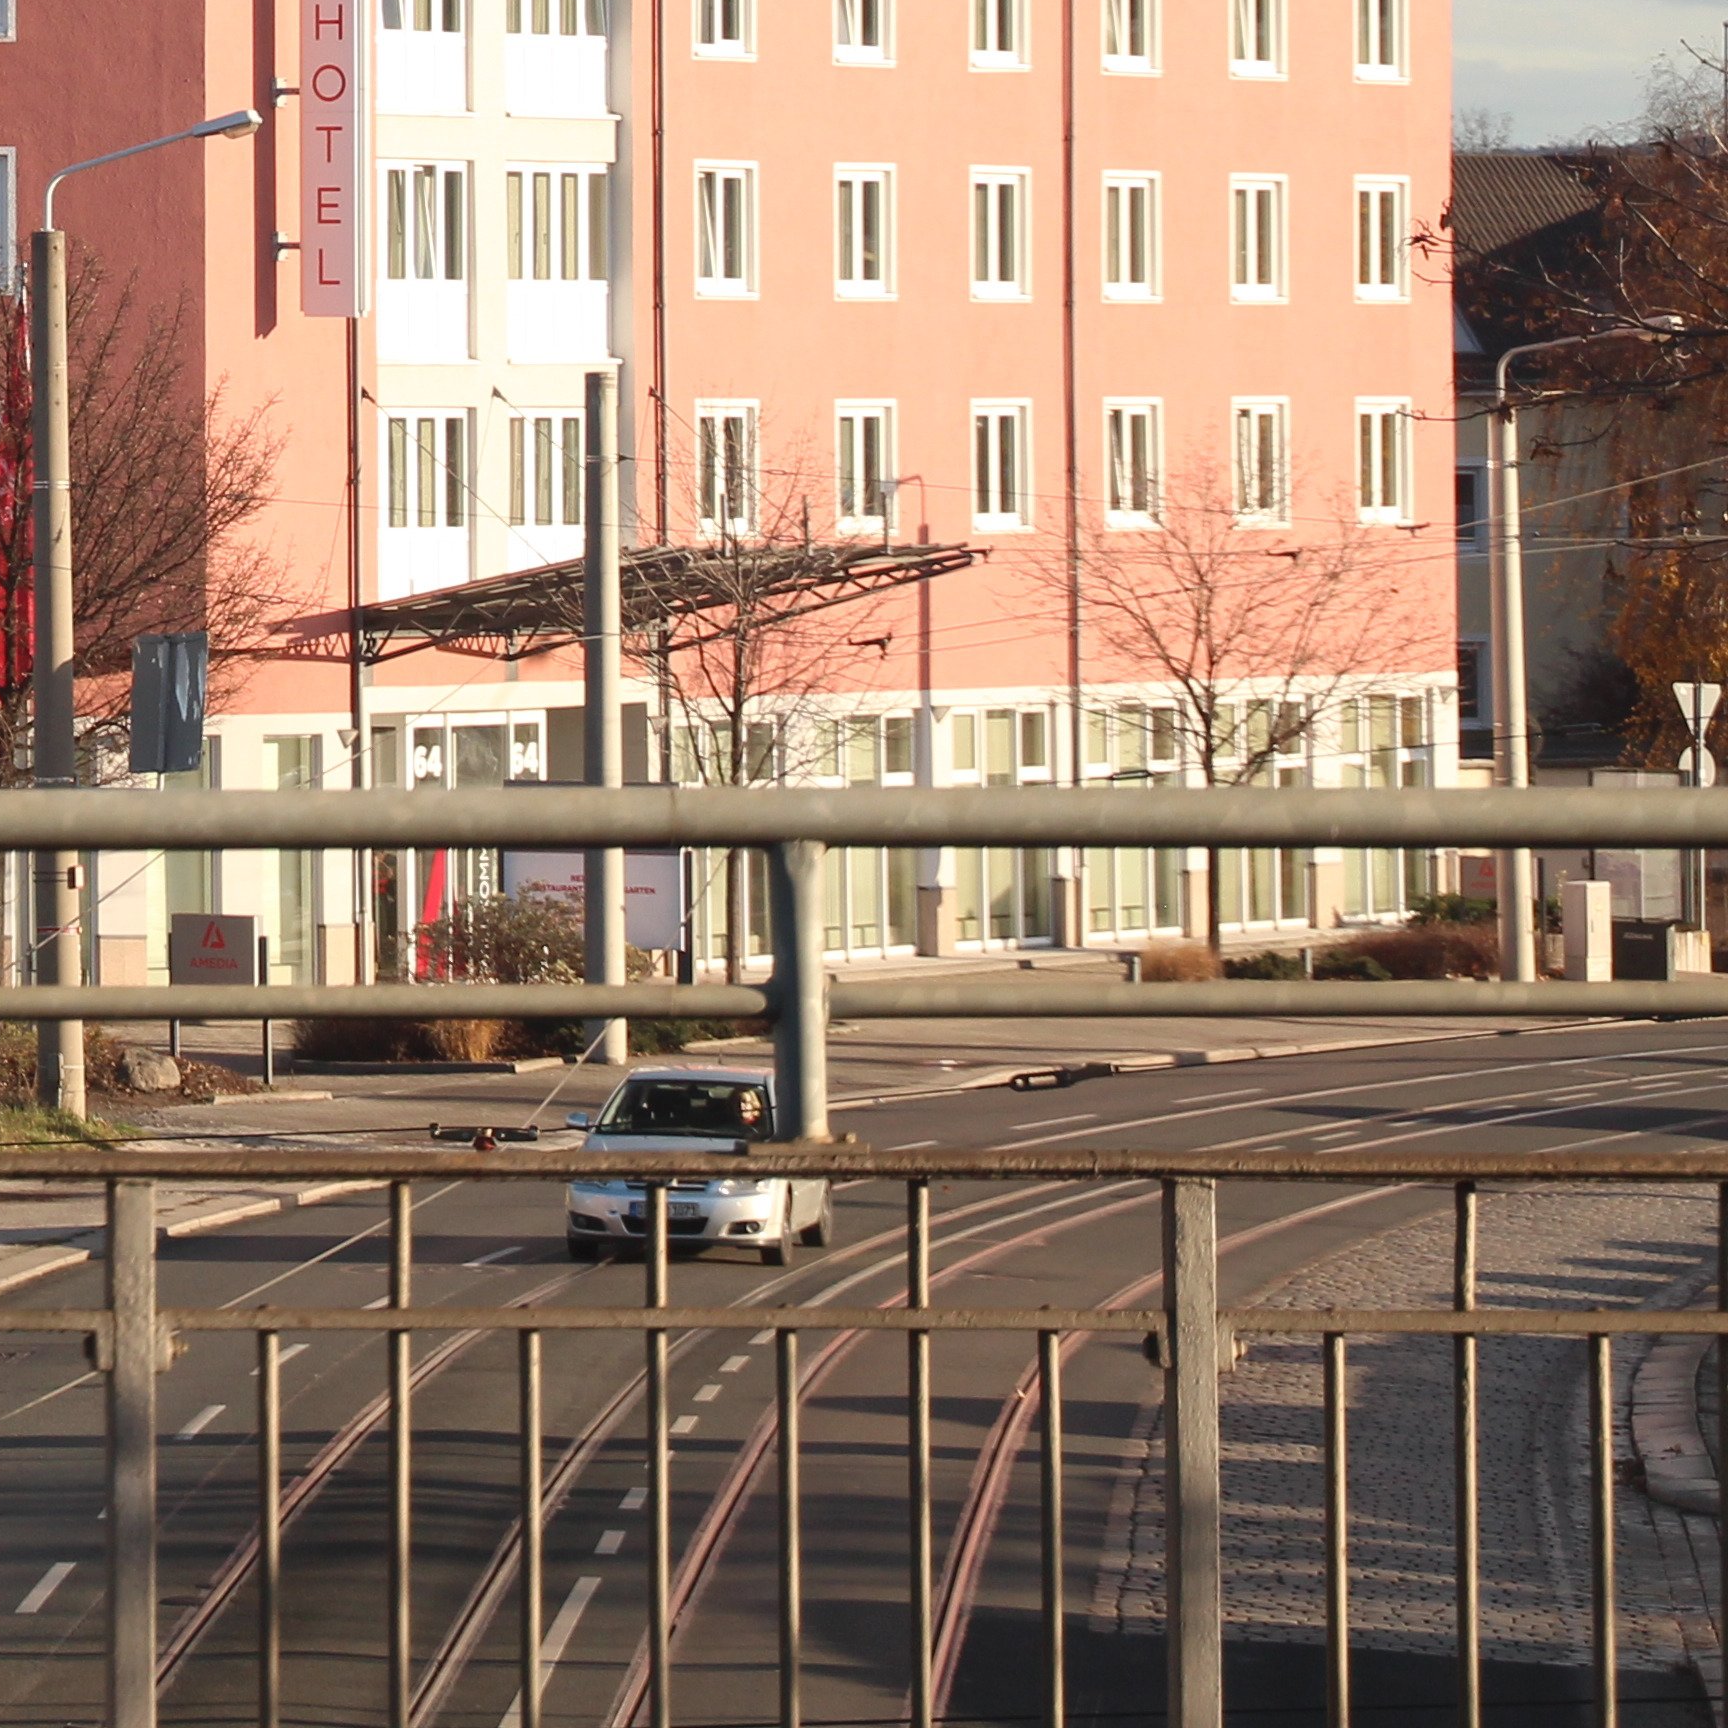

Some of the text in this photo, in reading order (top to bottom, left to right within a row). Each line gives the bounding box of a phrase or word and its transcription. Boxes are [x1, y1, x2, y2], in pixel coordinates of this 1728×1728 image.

[312, 3, 347, 285] HOTEL
[413, 745, 443, 779] 64
[511, 742, 539, 775] 64
[189, 958, 240, 969] AMEDIA
